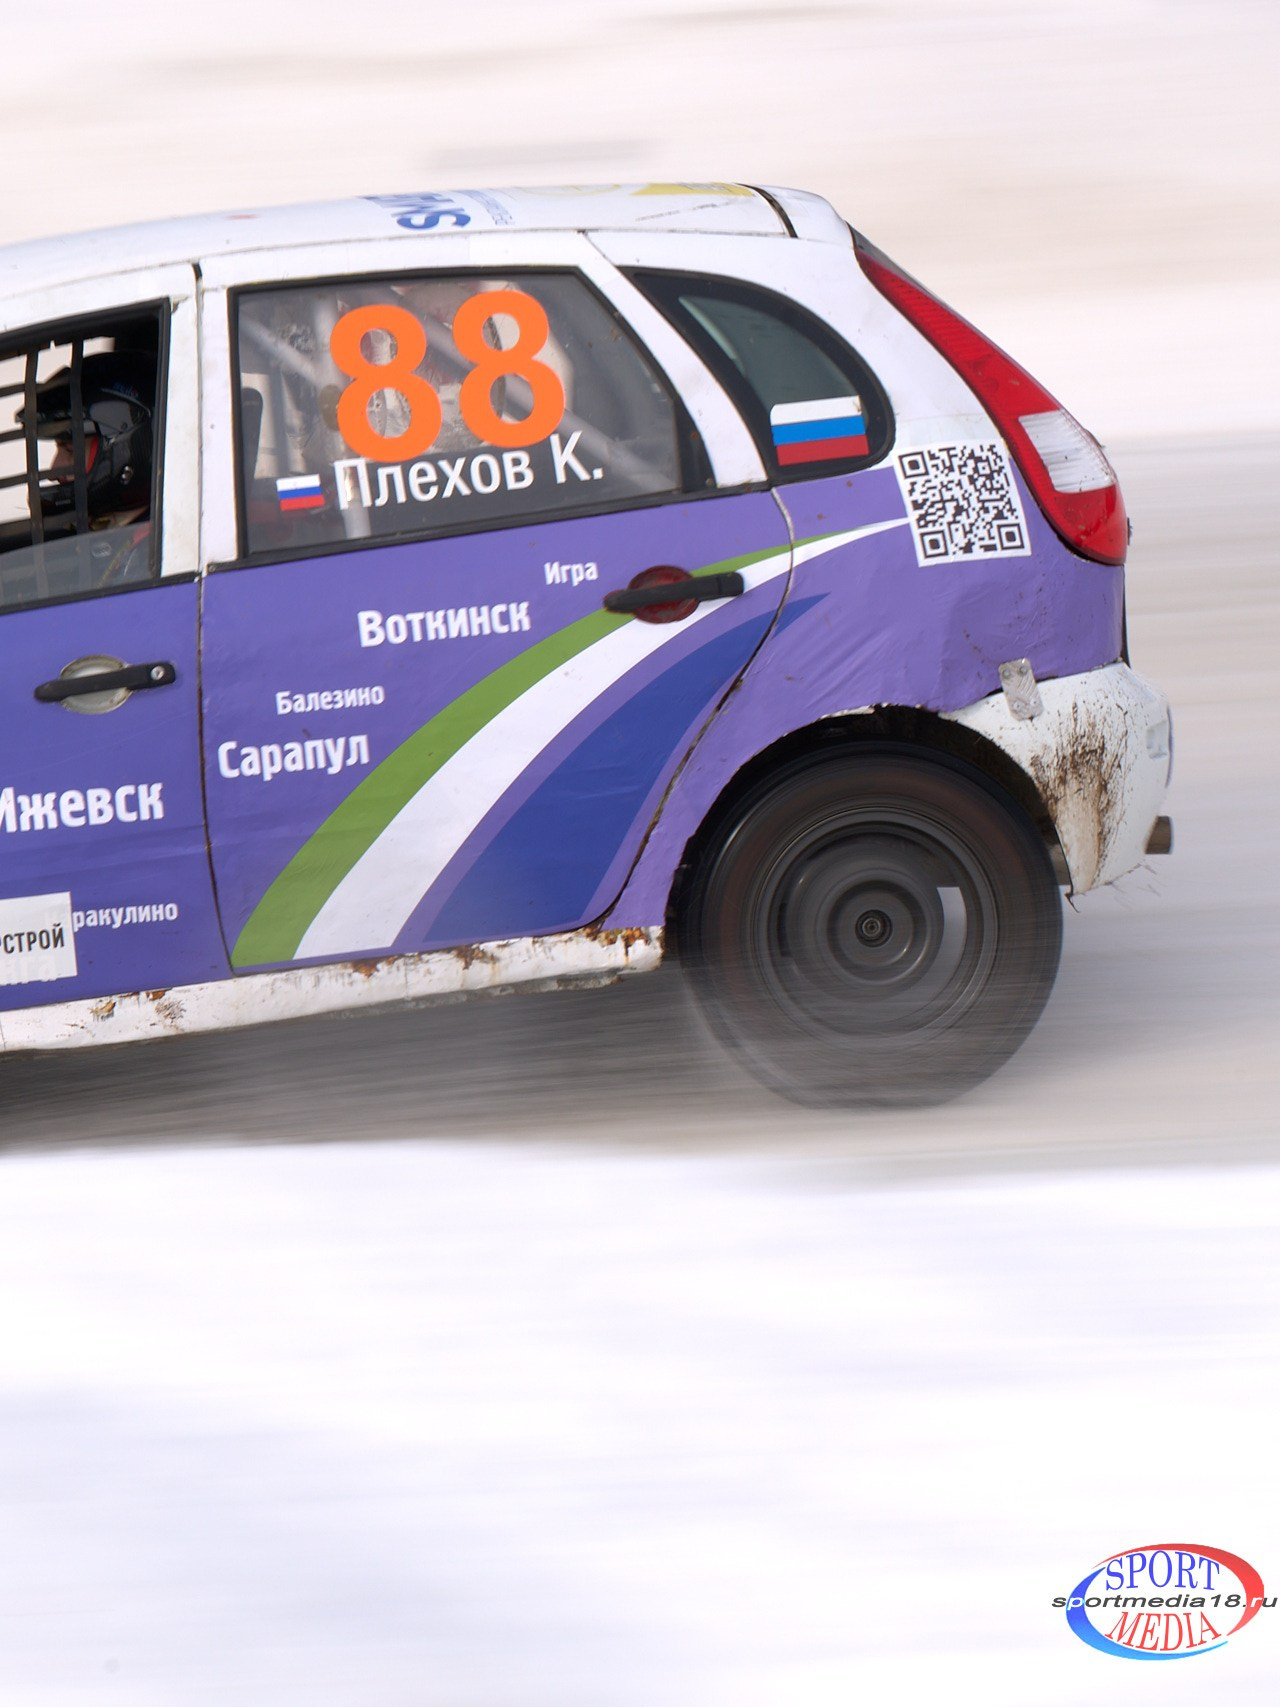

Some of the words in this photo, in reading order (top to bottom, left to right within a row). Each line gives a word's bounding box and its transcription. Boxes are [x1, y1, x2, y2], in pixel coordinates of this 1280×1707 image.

[330, 290, 565, 462] 88
[334, 449, 535, 510] Плехов
[549, 430, 604, 484] К.
[544, 561, 598, 587] Игра
[357, 601, 532, 647] Воткинск
[276, 685, 385, 715] Балезино
[218, 734, 370, 781] Сарапул
[72, 902, 179, 932] ракулино
